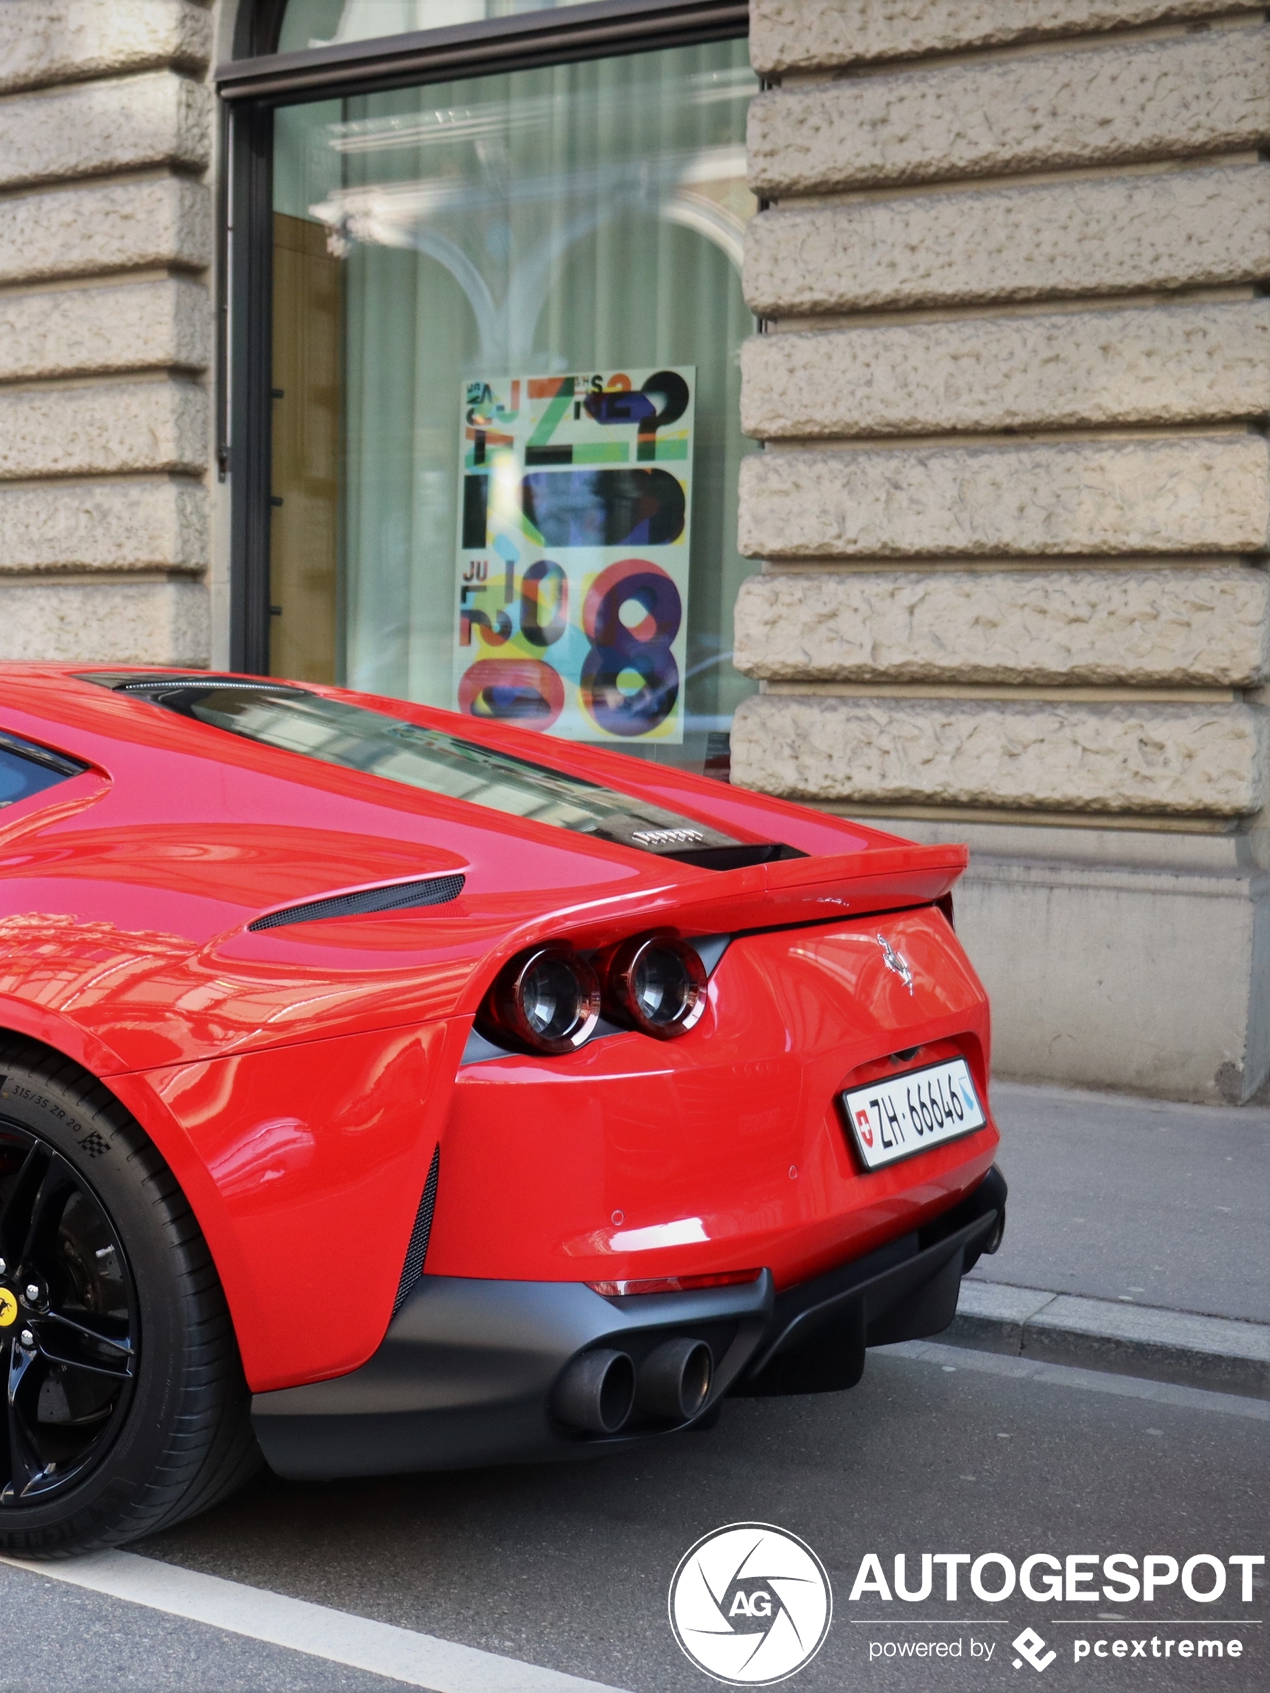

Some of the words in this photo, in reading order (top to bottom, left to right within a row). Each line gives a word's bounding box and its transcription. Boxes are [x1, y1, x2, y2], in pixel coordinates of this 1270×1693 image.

[12, 1085, 50, 1108] 315/35
[49, 1104, 66, 1120] ZR
[66, 1118, 82, 1132] 20
